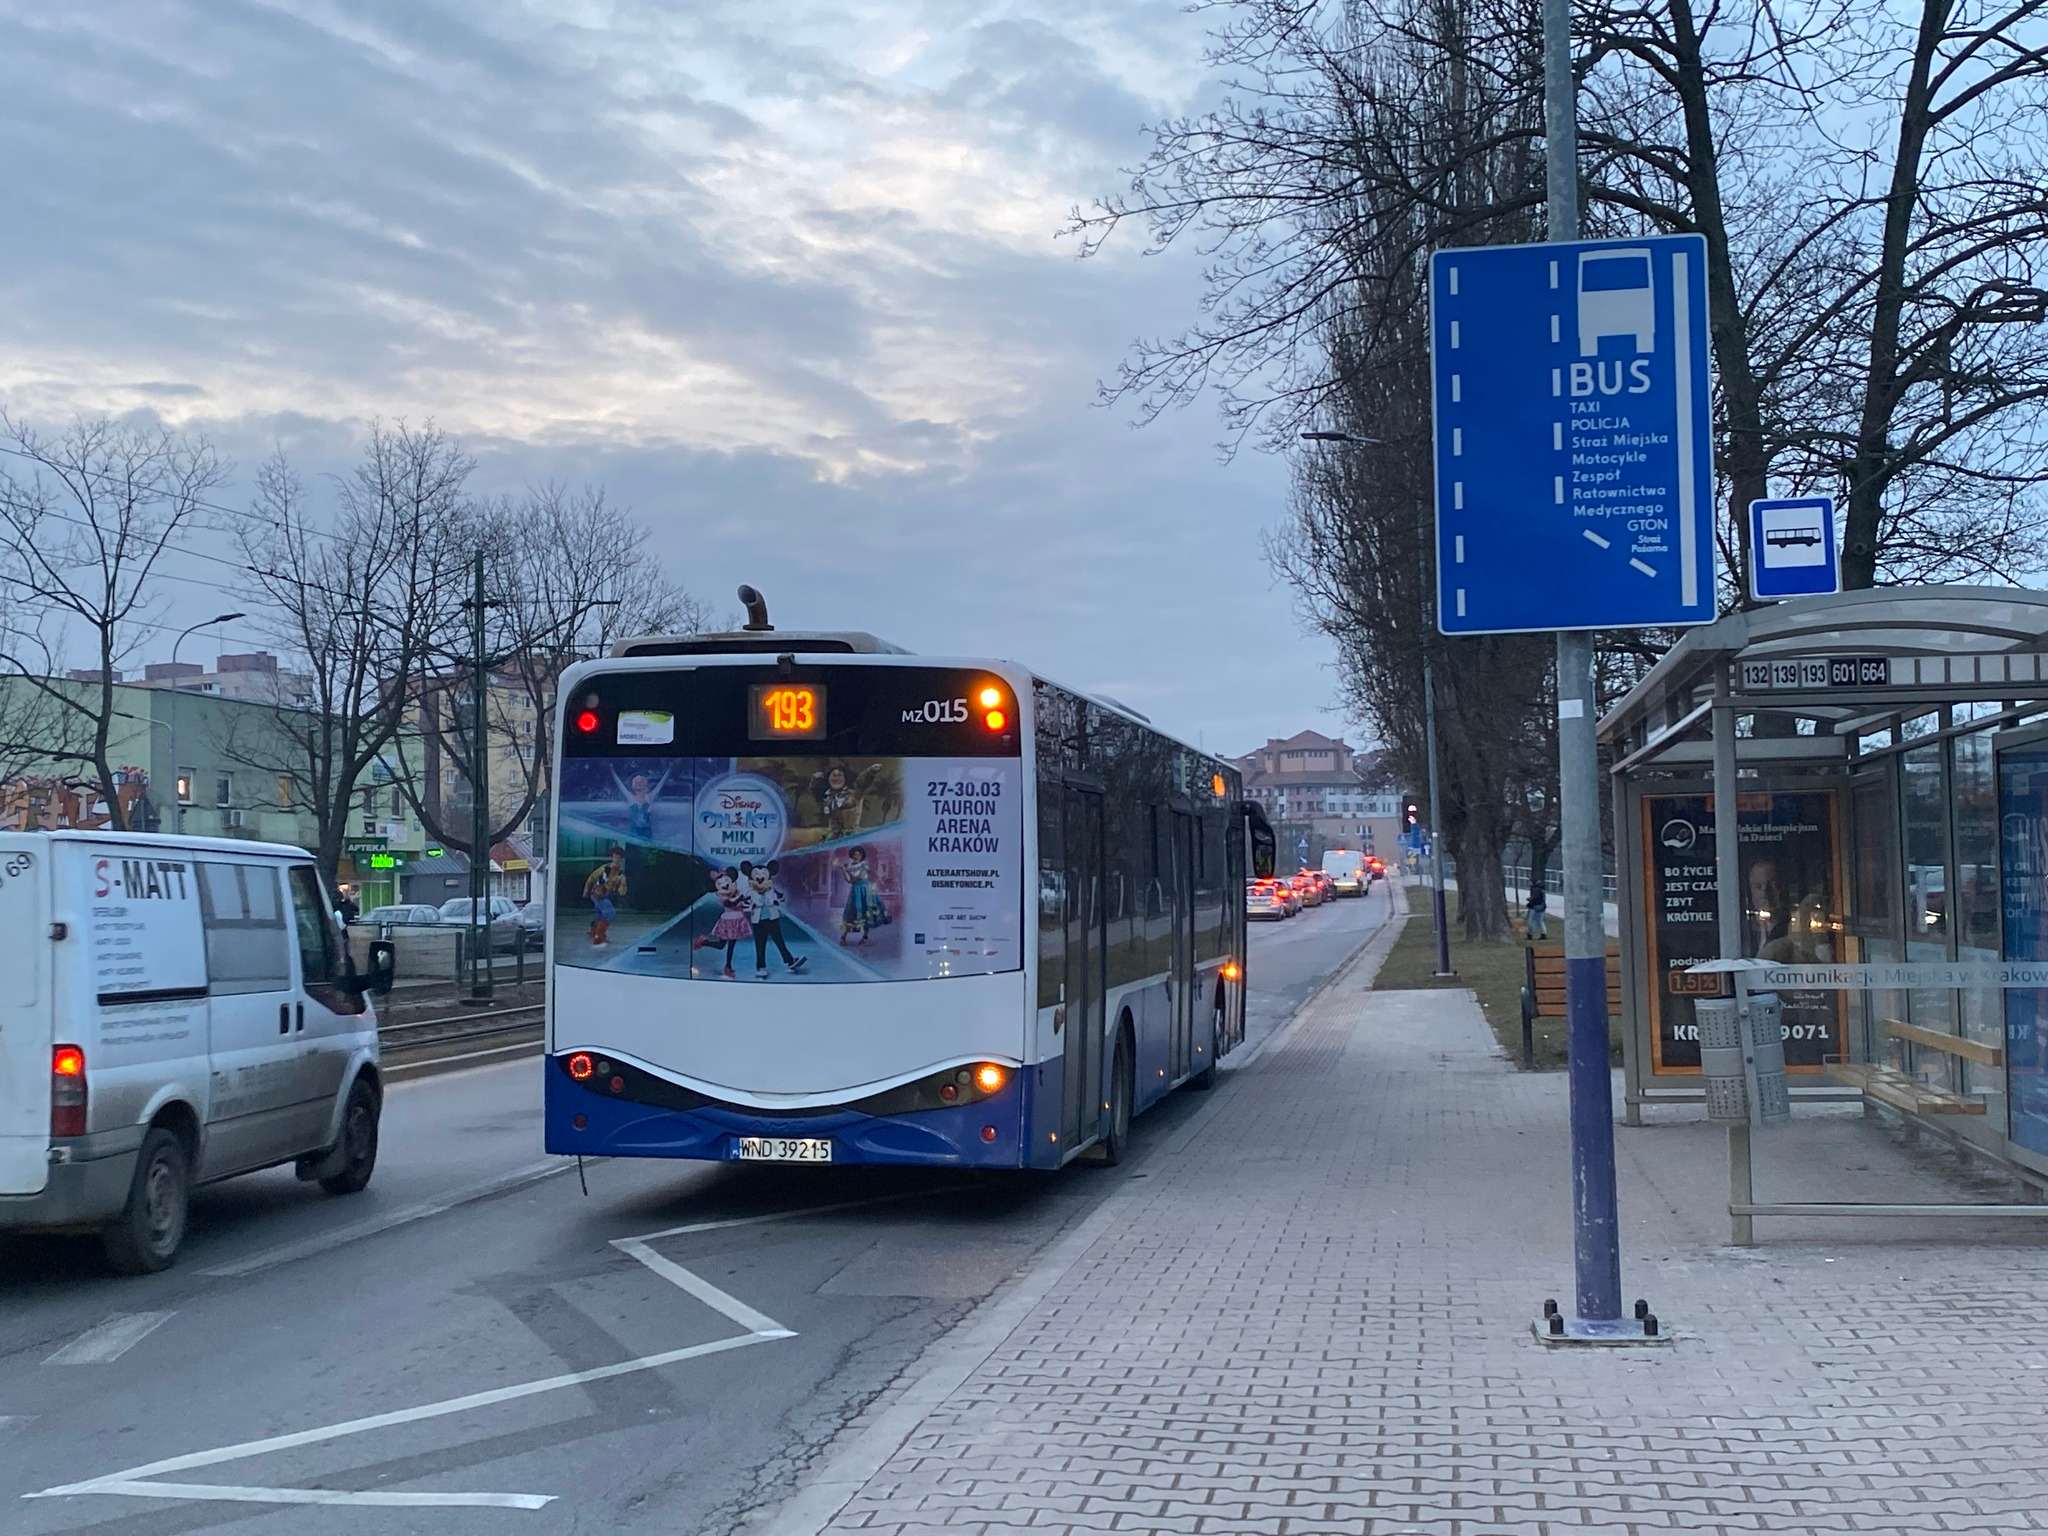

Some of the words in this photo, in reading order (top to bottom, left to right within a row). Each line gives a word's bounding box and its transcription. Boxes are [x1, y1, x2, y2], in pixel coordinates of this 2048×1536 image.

[1570, 359, 1651, 397] BUS
[1569, 401, 1600, 414] TAXI
[1571, 417, 1631, 431] POLICJA
[1572, 436, 1608, 448] Straż
[1613, 433, 1669, 447] Miejska
[1572, 451, 1647, 466] Motocykle
[1572, 468, 1621, 484] Zespół
[1573, 486, 1666, 500] Ratownictwa
[1573, 504, 1664, 519] Medycznego
[1627, 518, 1668, 531] GTON
[1744, 665, 1768, 684] 132
[1774, 665, 1797, 684] 139
[1802, 664, 1826, 683] 193
[1832, 664, 1855, 682] 601
[1861, 662, 1886, 681] 664
[764, 690, 814, 729] 193
[927, 781, 1001, 797] 27-30.03
[718, 793, 762, 812] Disney
[932, 800, 996, 815] TAURON
[936, 819, 991, 834] ARENA
[721, 831, 755, 844] MIKI
[928, 834, 999, 853] KRAKÓW
[348, 844, 386, 852] APTEKA
[1664, 867, 1680, 877] BO
[1683, 865, 1714, 876] ŻYCIE
[96, 858, 187, 900] S-MATT
[1665, 882, 1690, 892] JEST
[1666, 897, 1694, 907] ZBYT
[1666, 911, 1713, 922] KRÓTKIE
[741, 1140, 772, 1158] WND
[779, 1141, 829, 1159] 39215
